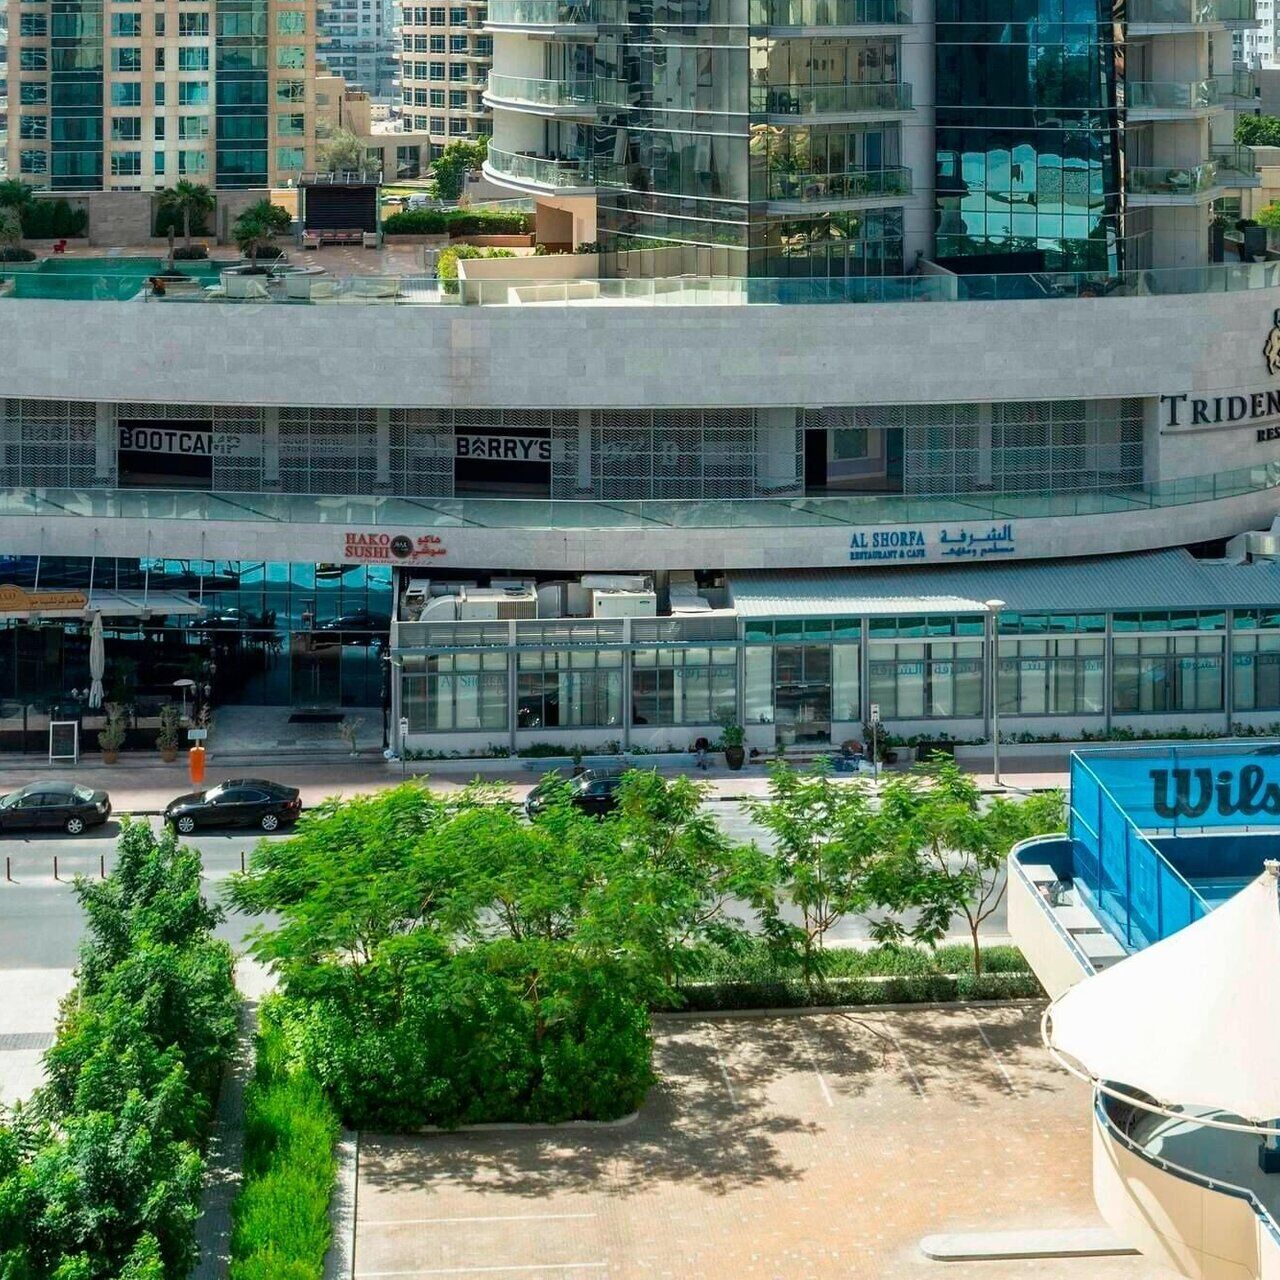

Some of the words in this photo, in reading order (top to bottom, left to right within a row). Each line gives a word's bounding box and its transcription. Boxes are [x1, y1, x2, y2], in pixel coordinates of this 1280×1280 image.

[345, 533, 390, 546] HAKO
[850, 532, 869, 549] AL
[872, 530, 926, 548] SHORFA
[940, 524, 1014, 548] الشرفة
[345, 546, 389, 558] SUSHI
